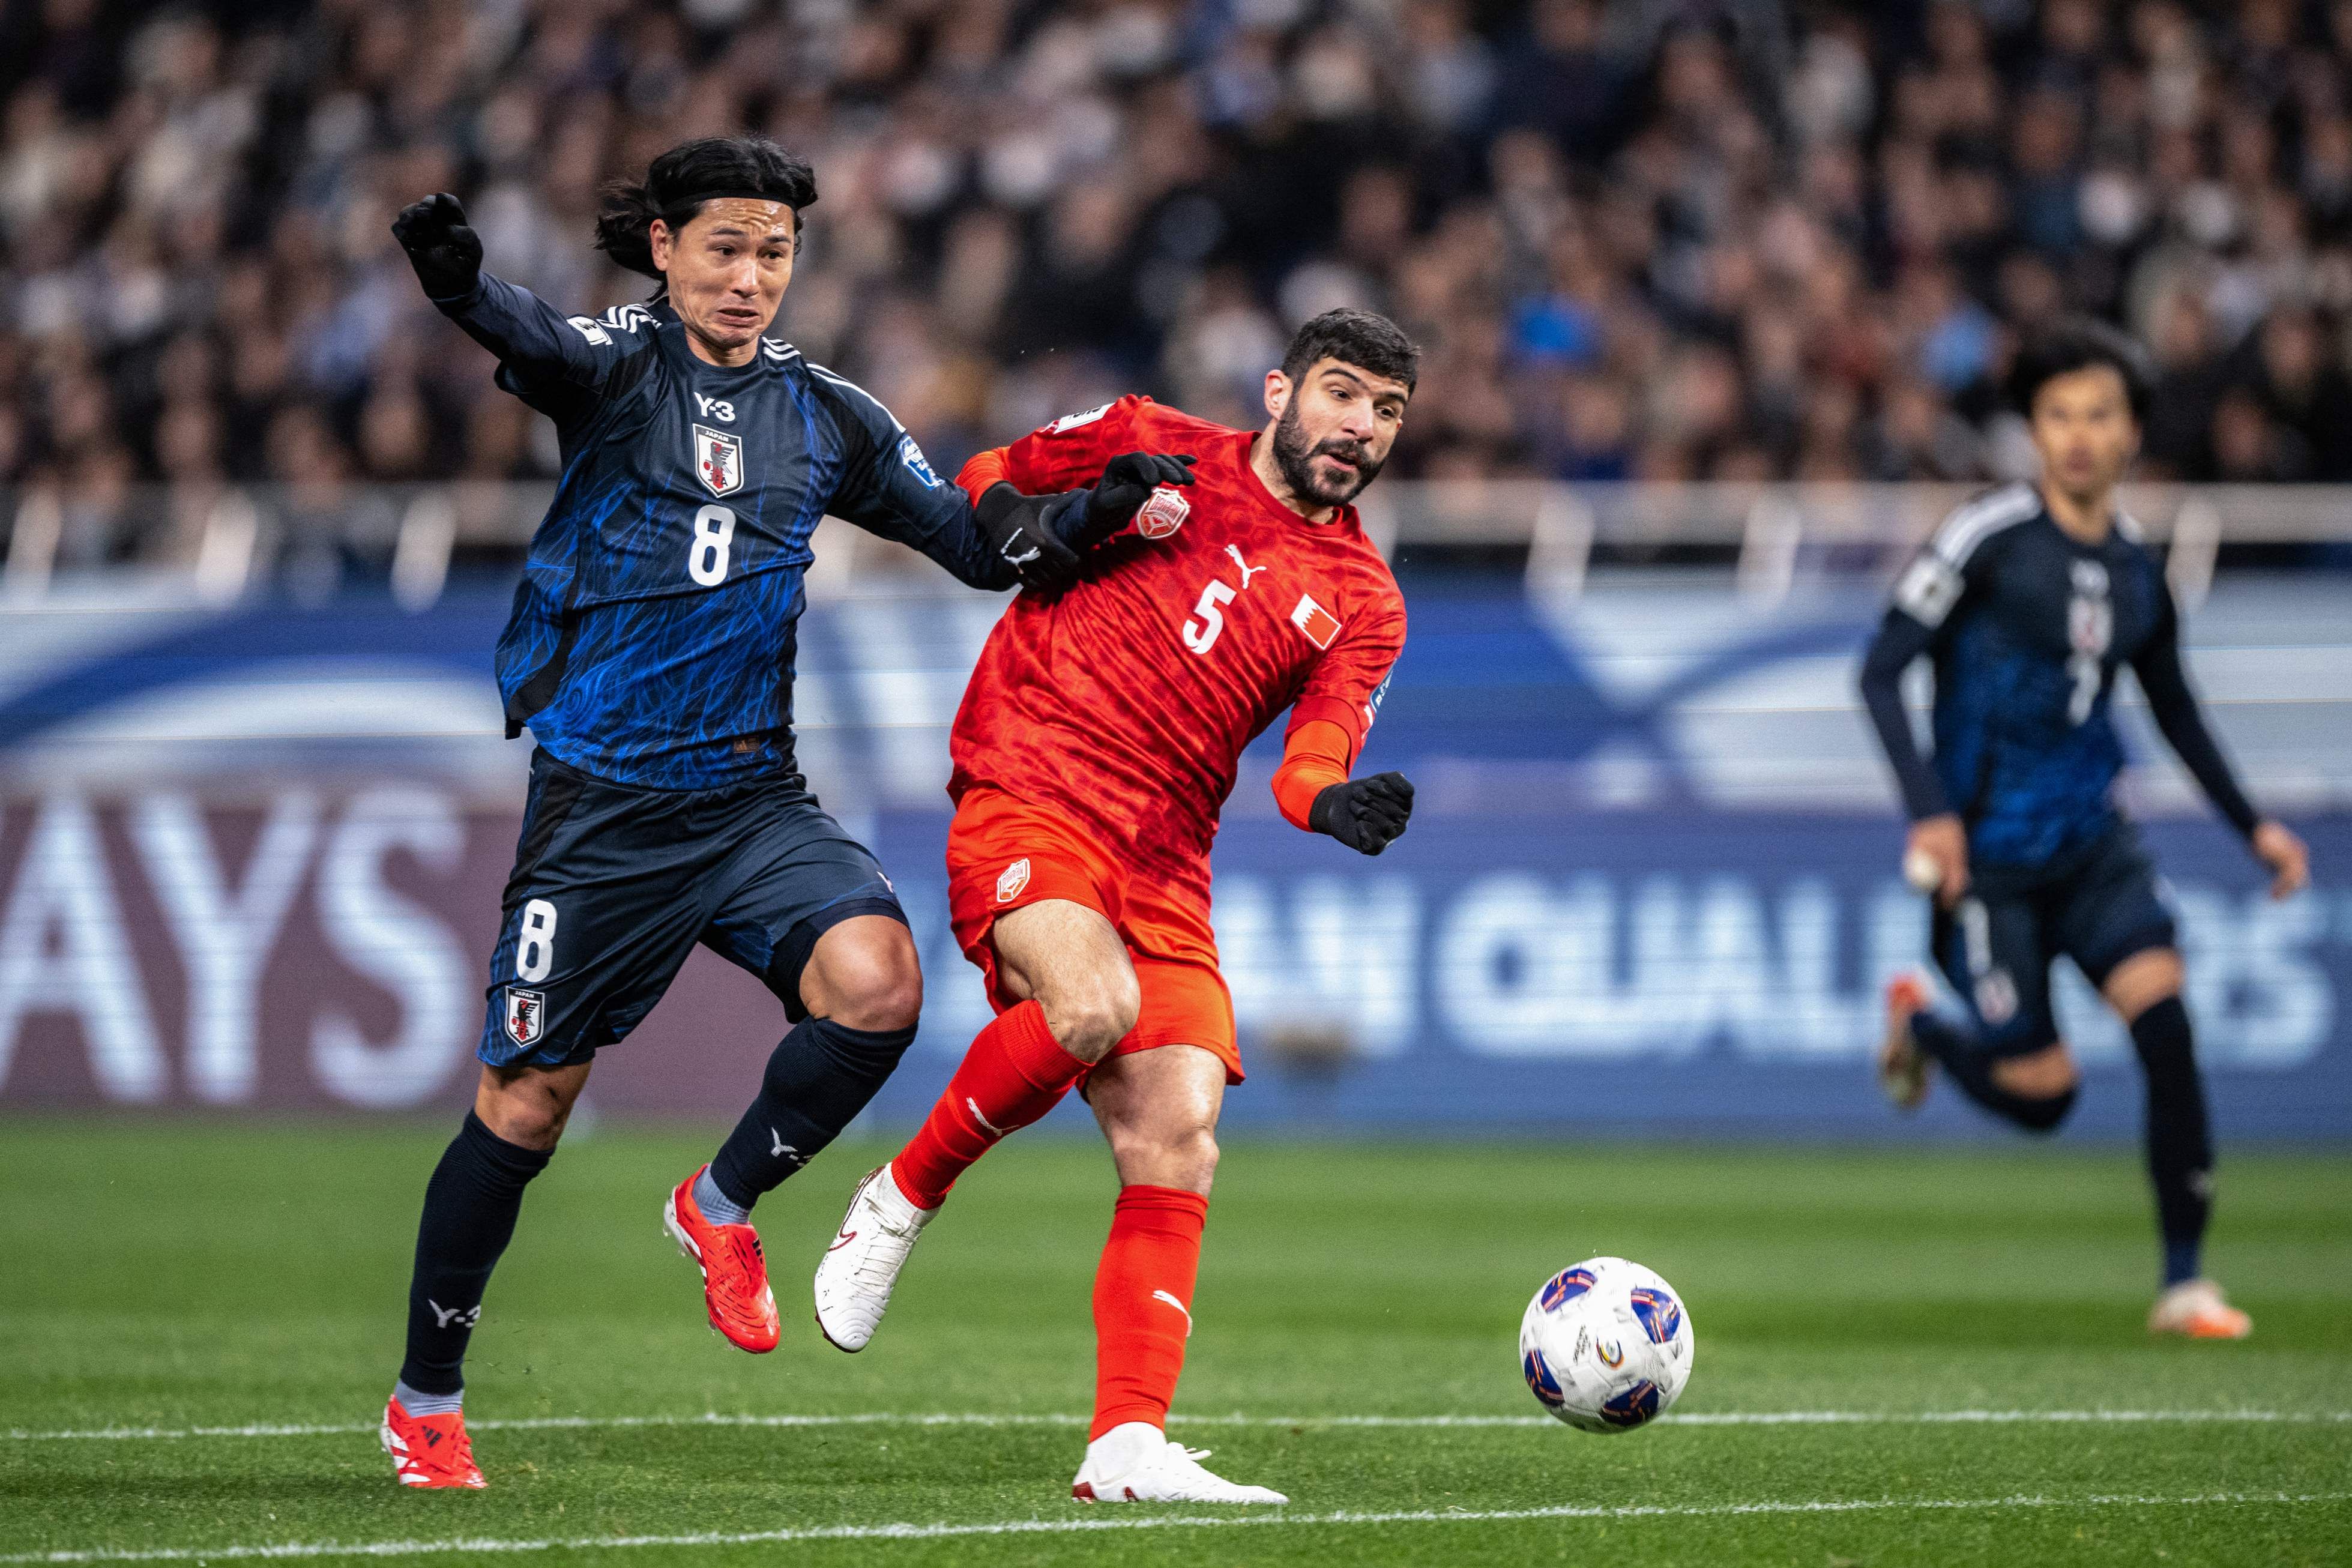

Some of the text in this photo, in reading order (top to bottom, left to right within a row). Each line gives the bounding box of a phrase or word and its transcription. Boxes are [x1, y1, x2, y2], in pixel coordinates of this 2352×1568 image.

[693, 391, 736, 422] Y-3
[705, 430, 729, 442] JAPAN
[688, 504, 737, 586] 8
[1182, 579, 1237, 654] 5
[0, 783, 472, 1109] AYS
[516, 899, 558, 983] 8
